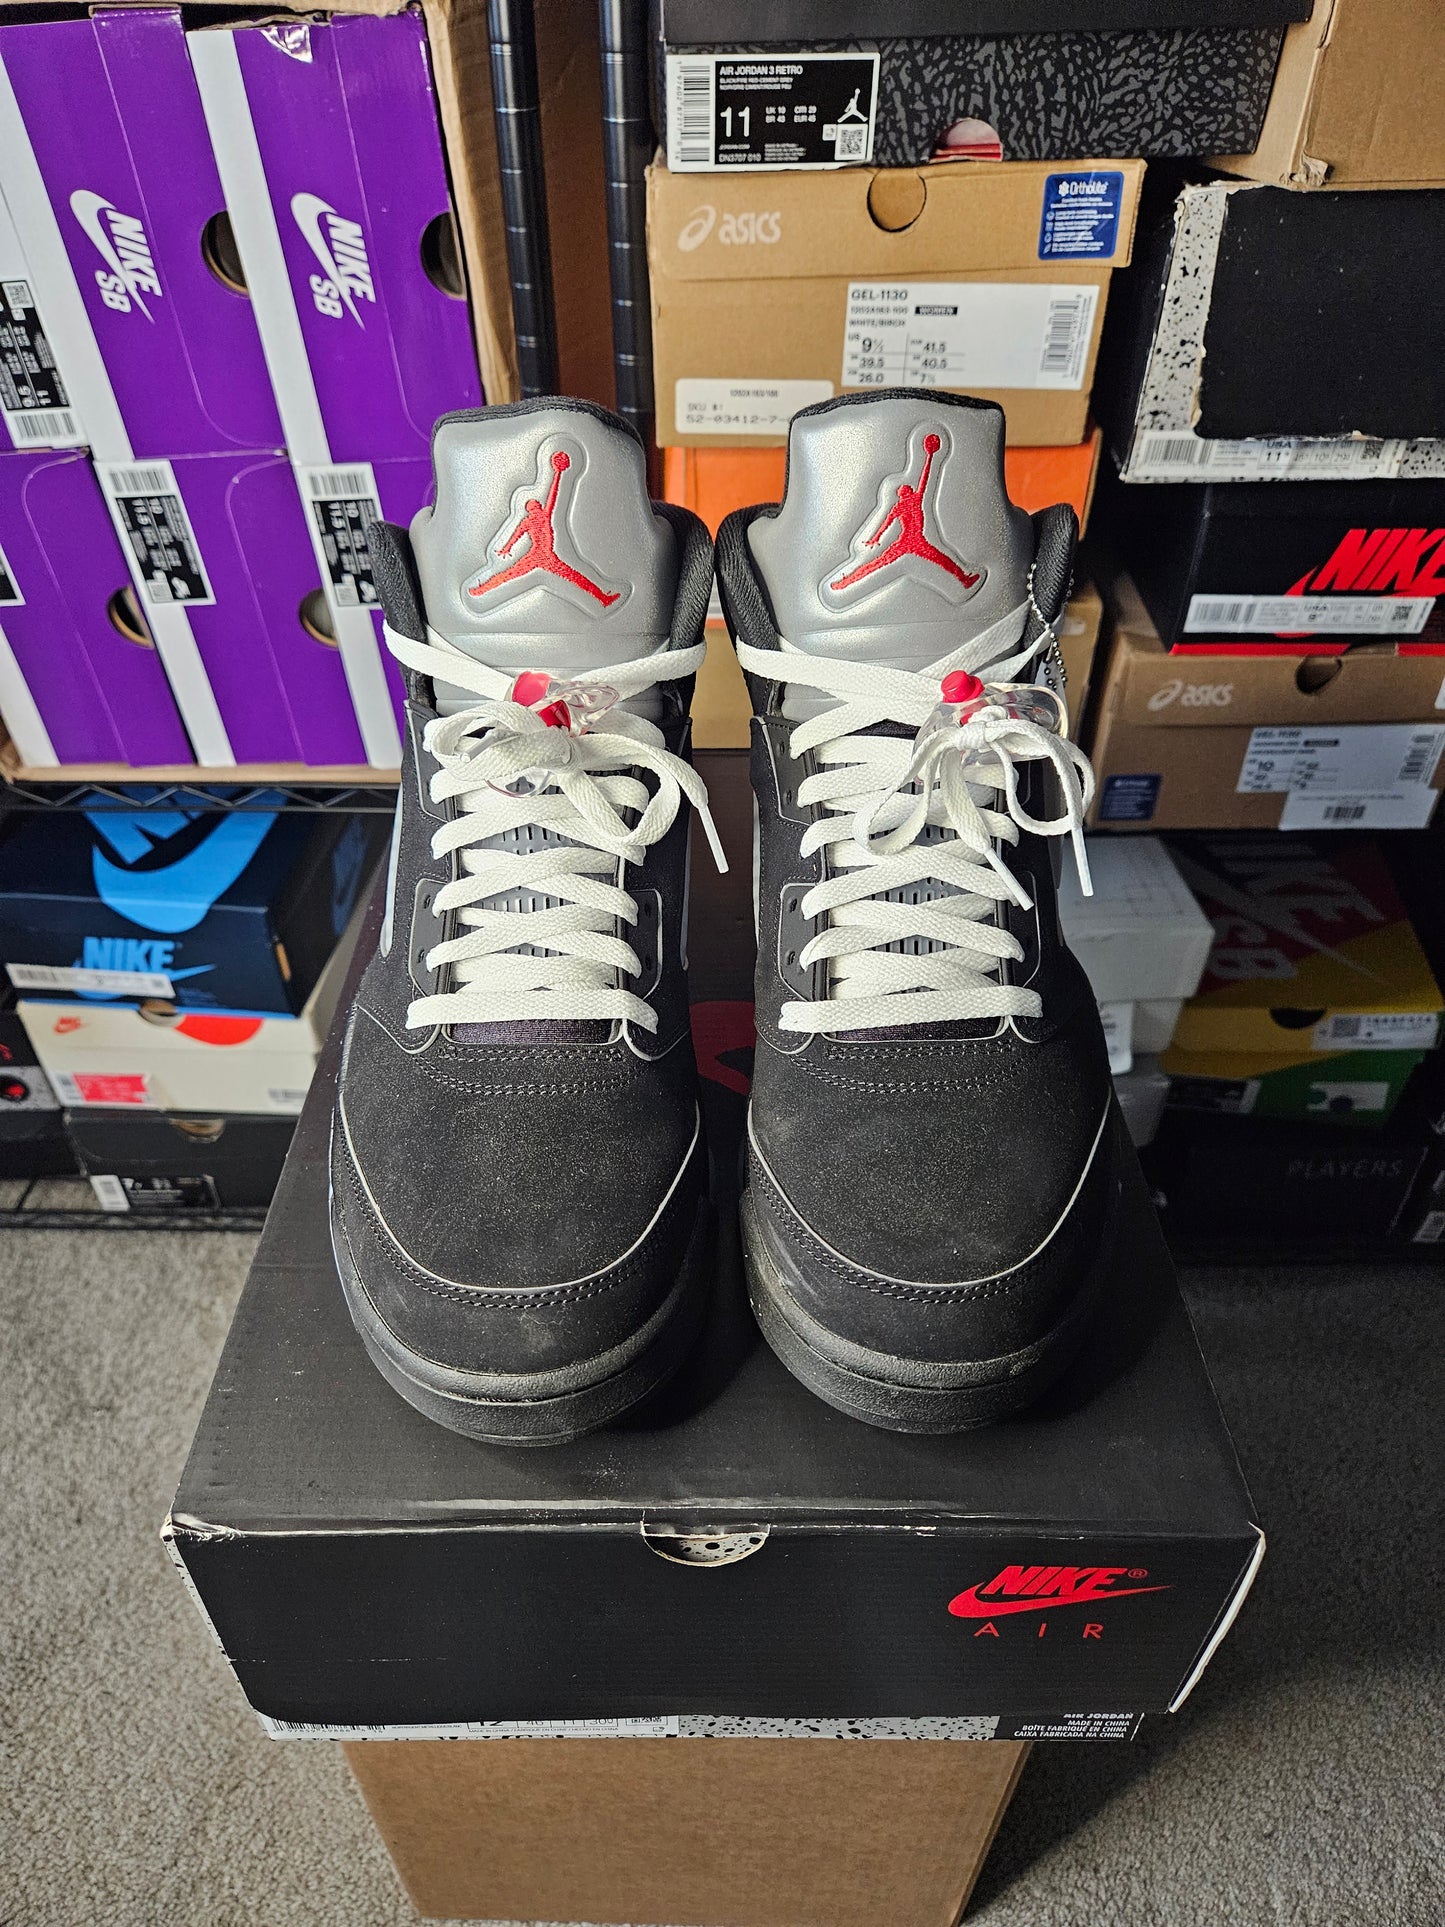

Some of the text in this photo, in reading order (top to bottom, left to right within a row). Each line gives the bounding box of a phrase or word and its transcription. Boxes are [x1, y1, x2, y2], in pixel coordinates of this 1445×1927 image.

[720, 65, 804, 76] AIR JORDAN 3 RETRO
[720, 106, 751, 138] 11
[719, 211, 782, 246] asics
[106, 209, 163, 297] NIKE
[325, 213, 376, 303] NIKE
[94, 269, 131, 313] SB
[309, 274, 343, 319] SB
[851, 289, 909, 301] GEL-1130
[923, 342, 947, 354] 41.5
[859, 357, 885, 369] 39.5
[921, 358, 948, 370] 40.5
[858, 373, 885, 384] 26.0
[688, 403, 707, 411] SKU
[1181, 683, 1233, 706] asics
[84, 936, 176, 973] NIKE
[1286, 1158, 1403, 1180] PLAYERS
[979, 1565, 1128, 1596] NIKE
